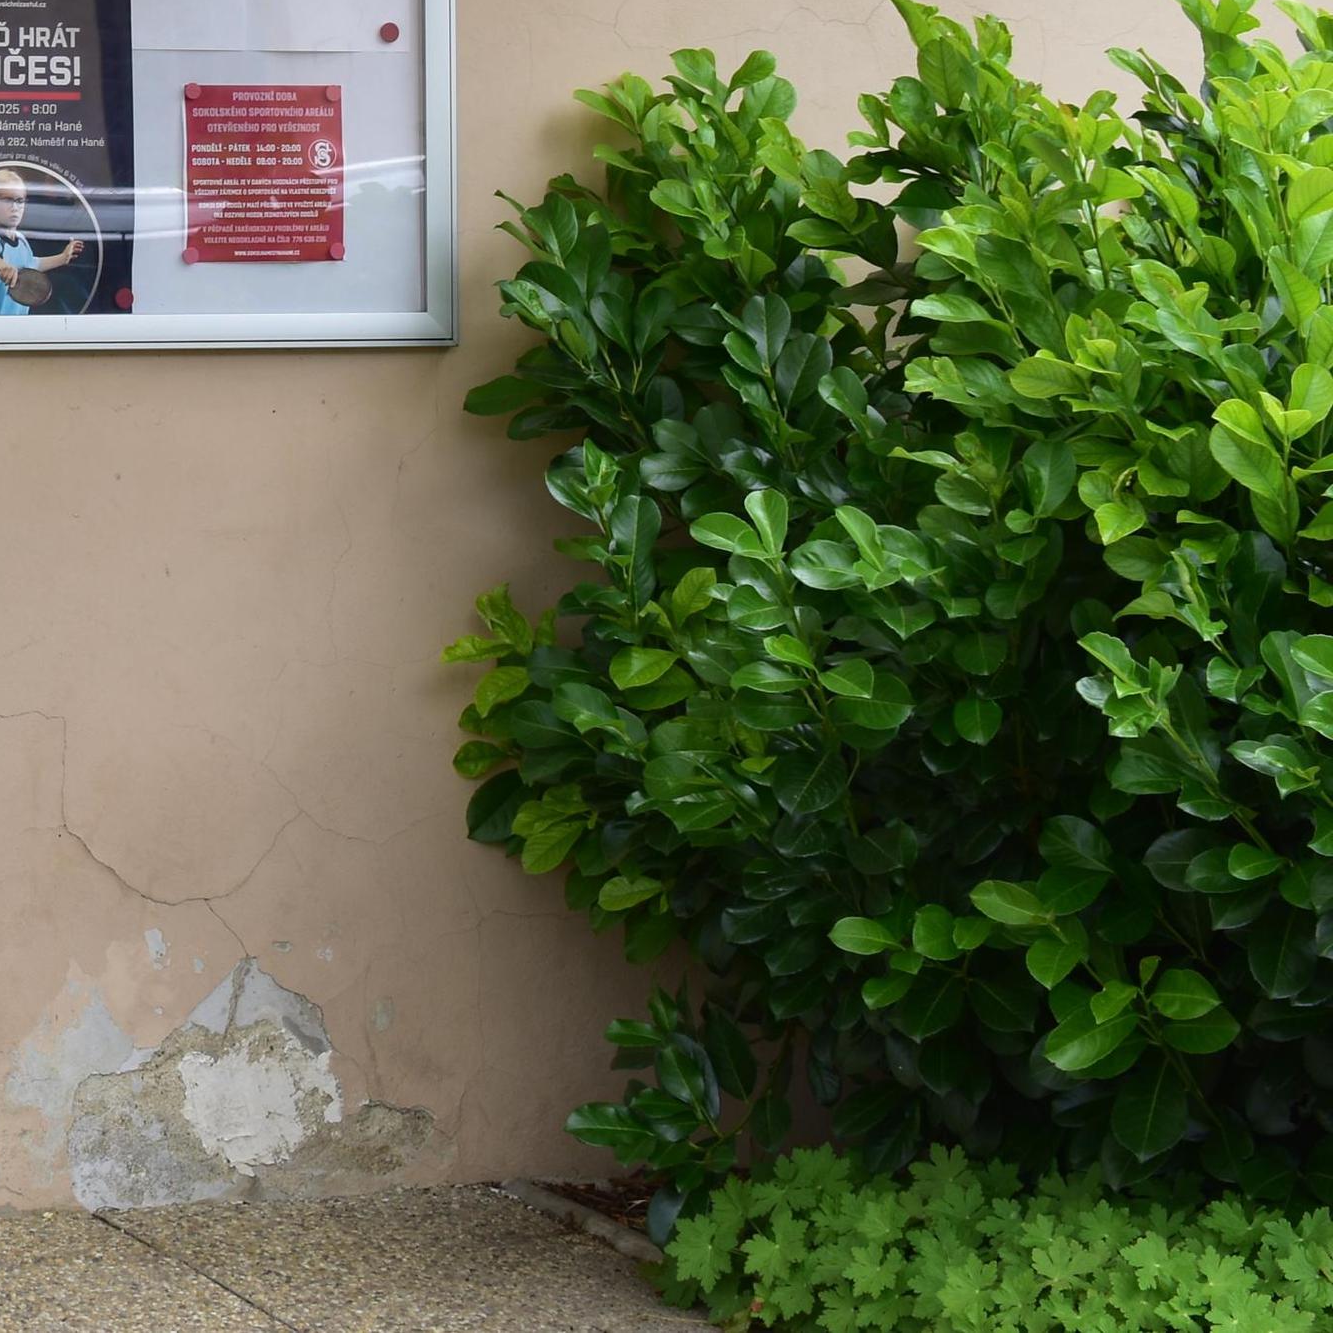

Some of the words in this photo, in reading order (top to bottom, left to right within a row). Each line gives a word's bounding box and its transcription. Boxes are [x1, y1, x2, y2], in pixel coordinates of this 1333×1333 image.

[19, 22, 81, 48] HRÁT
[32, 104, 57, 115] 8:00
[38, 122, 52, 131] na
[55, 121, 83, 132] Hané
[7, 137, 28, 148] 282,
[67, 139, 79, 147] na
[81, 138, 105, 147] Hané
